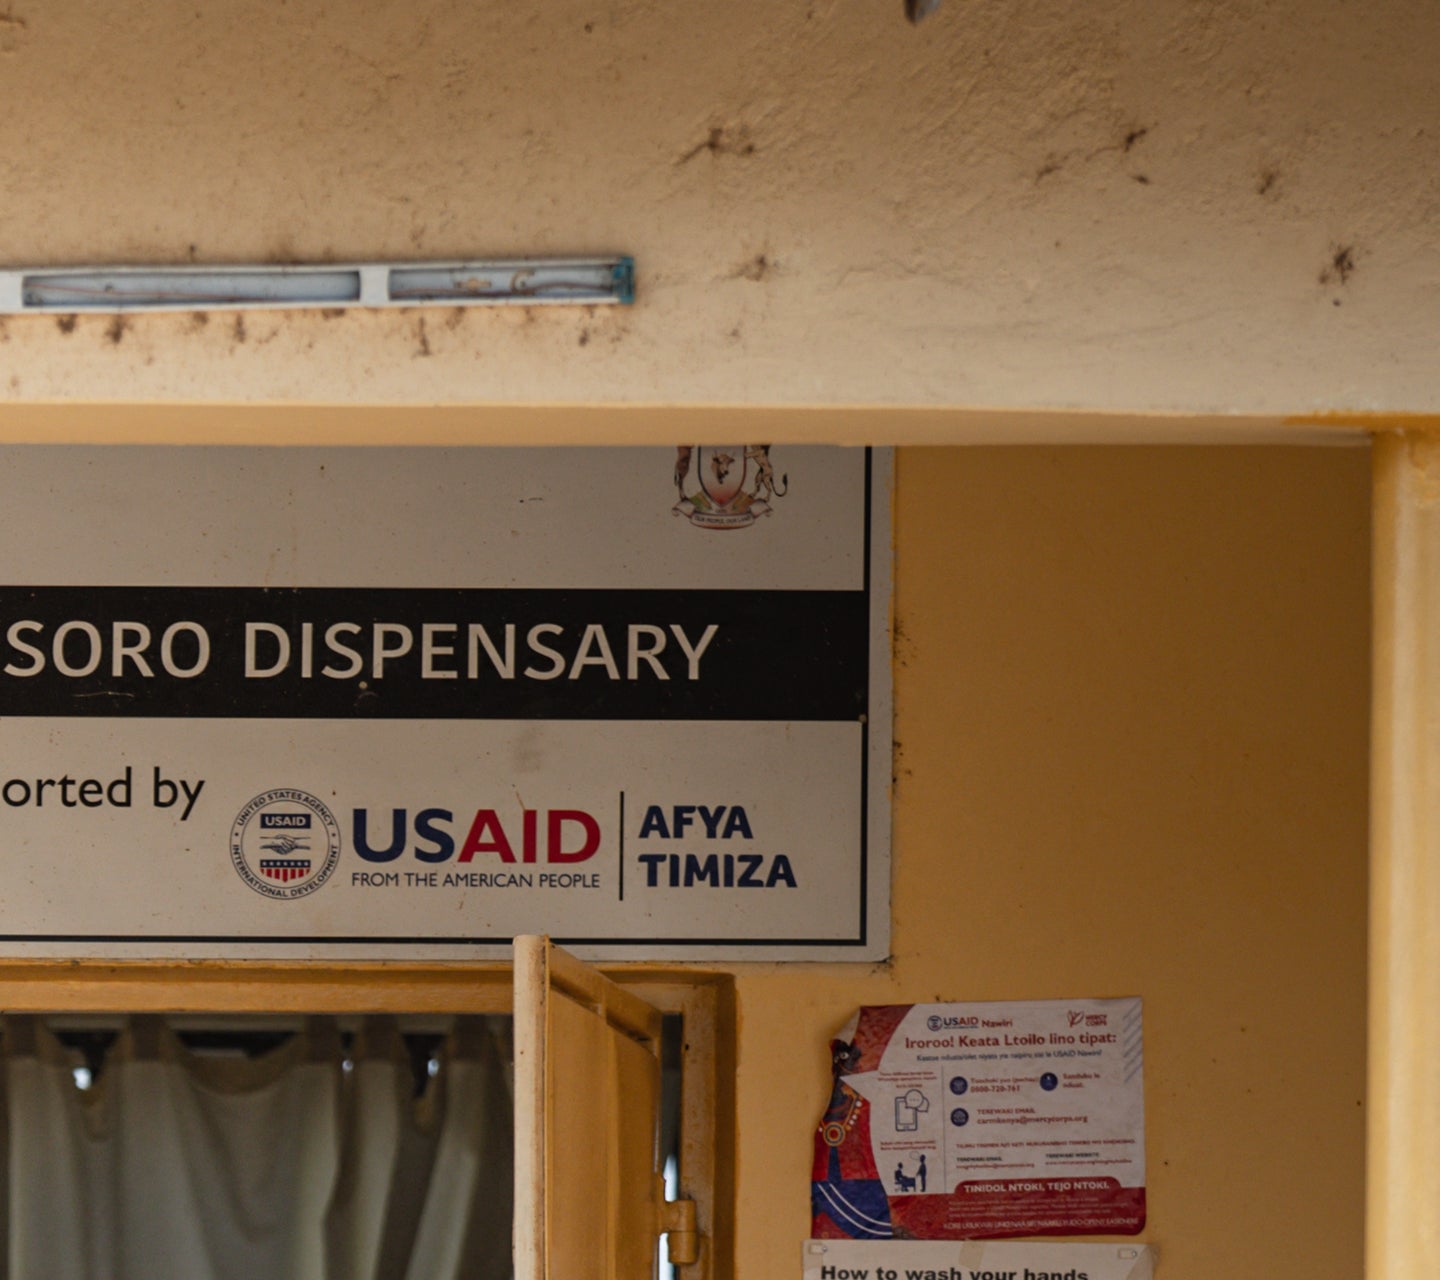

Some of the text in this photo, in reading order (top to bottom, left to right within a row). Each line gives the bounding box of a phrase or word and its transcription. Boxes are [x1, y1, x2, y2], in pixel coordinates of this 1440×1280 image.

[244, 622, 719, 683] DISPENSARY
[153, 766, 205, 820] by
[237, 791, 335, 827] UNITED STATES AGENCY
[265, 816, 306, 826] USAID
[353, 808, 601, 864] USAID
[638, 805, 754, 839] AFYA
[232, 844, 338, 897] INTERNATIONAL DEVELOPMENT
[352, 873, 600, 888] FROM THE AMERICAN PEOPLE
[638, 854, 798, 888] TIMIZA
[943, 1016, 1013, 1028] USAID Nawiri
[959, 1036, 1000, 1047] Keata
[1079, 1033, 1117, 1048] tipat:
[1048, 1182, 1071, 1191] TEJO
[820, 1265, 868, 1280] How
[876, 1266, 897, 1280] to
